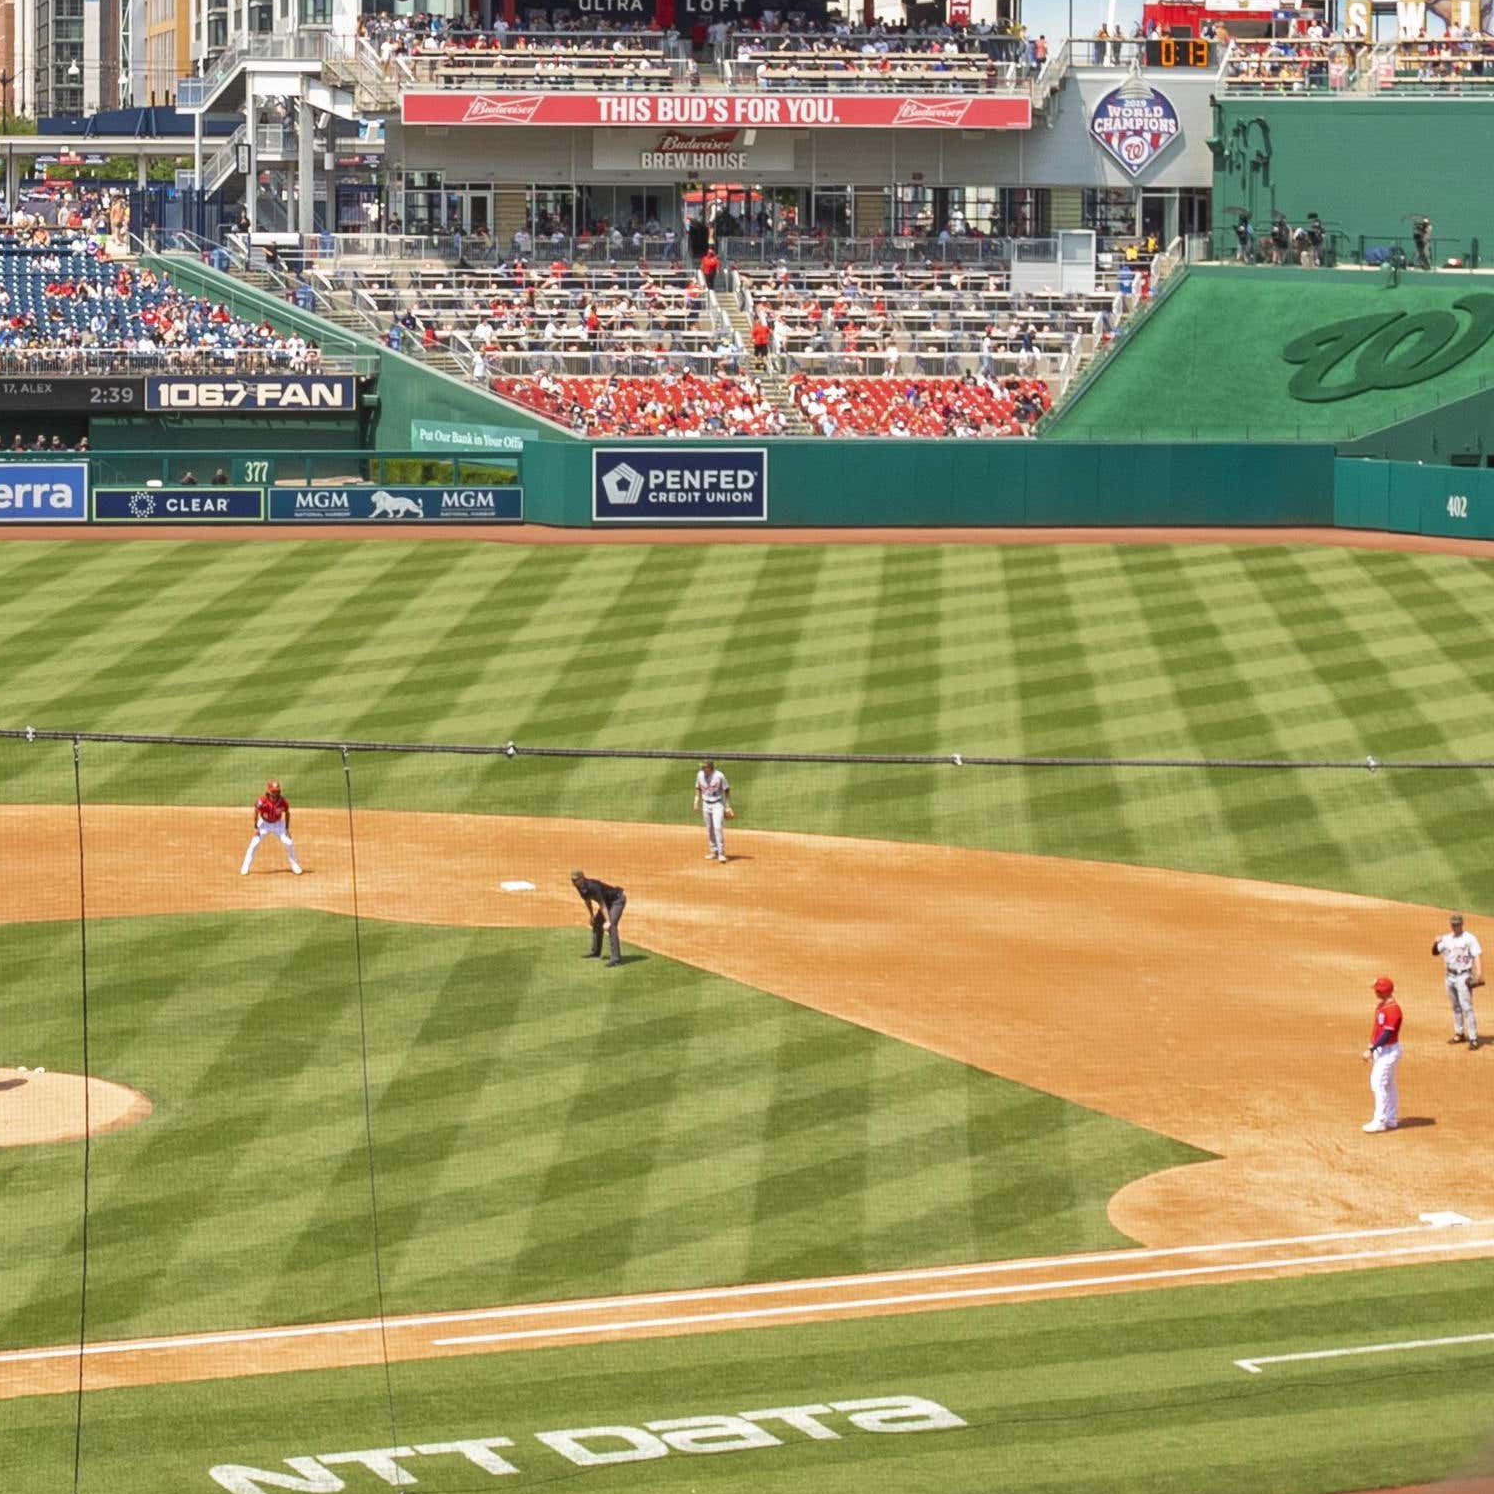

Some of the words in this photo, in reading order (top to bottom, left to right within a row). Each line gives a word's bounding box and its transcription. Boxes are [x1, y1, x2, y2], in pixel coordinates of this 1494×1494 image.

[598, 97, 651, 120] THIS
[658, 97, 730, 121] BUD'S
[734, 98, 774, 121] FOR
[779, 99, 841, 122] YOU.
[1107, 105, 1164, 118] WORLD
[1094, 117, 1177, 133] CHAMPIONS
[664, 136, 735, 152] Budweiser
[642, 152, 683, 170] BREW
[689, 152, 748, 171] HOUSE
[21, 383, 52, 393] ALEX
[90, 387, 134, 404] 2:39
[257, 383, 342, 407] FAN
[434, 430, 451, 444] Our
[452, 431, 473, 446] Bank
[474, 434, 482, 446] in
[483, 434, 505, 449] Your
[244, 461, 269, 482] 377
[649, 469, 756, 490] PENFED
[166, 498, 228, 512] CLEAR
[295, 491, 350, 508] MGM
[440, 489, 495, 508] MGM
[649, 492, 702, 504] CREDIT
[706, 491, 754, 504] UNION
